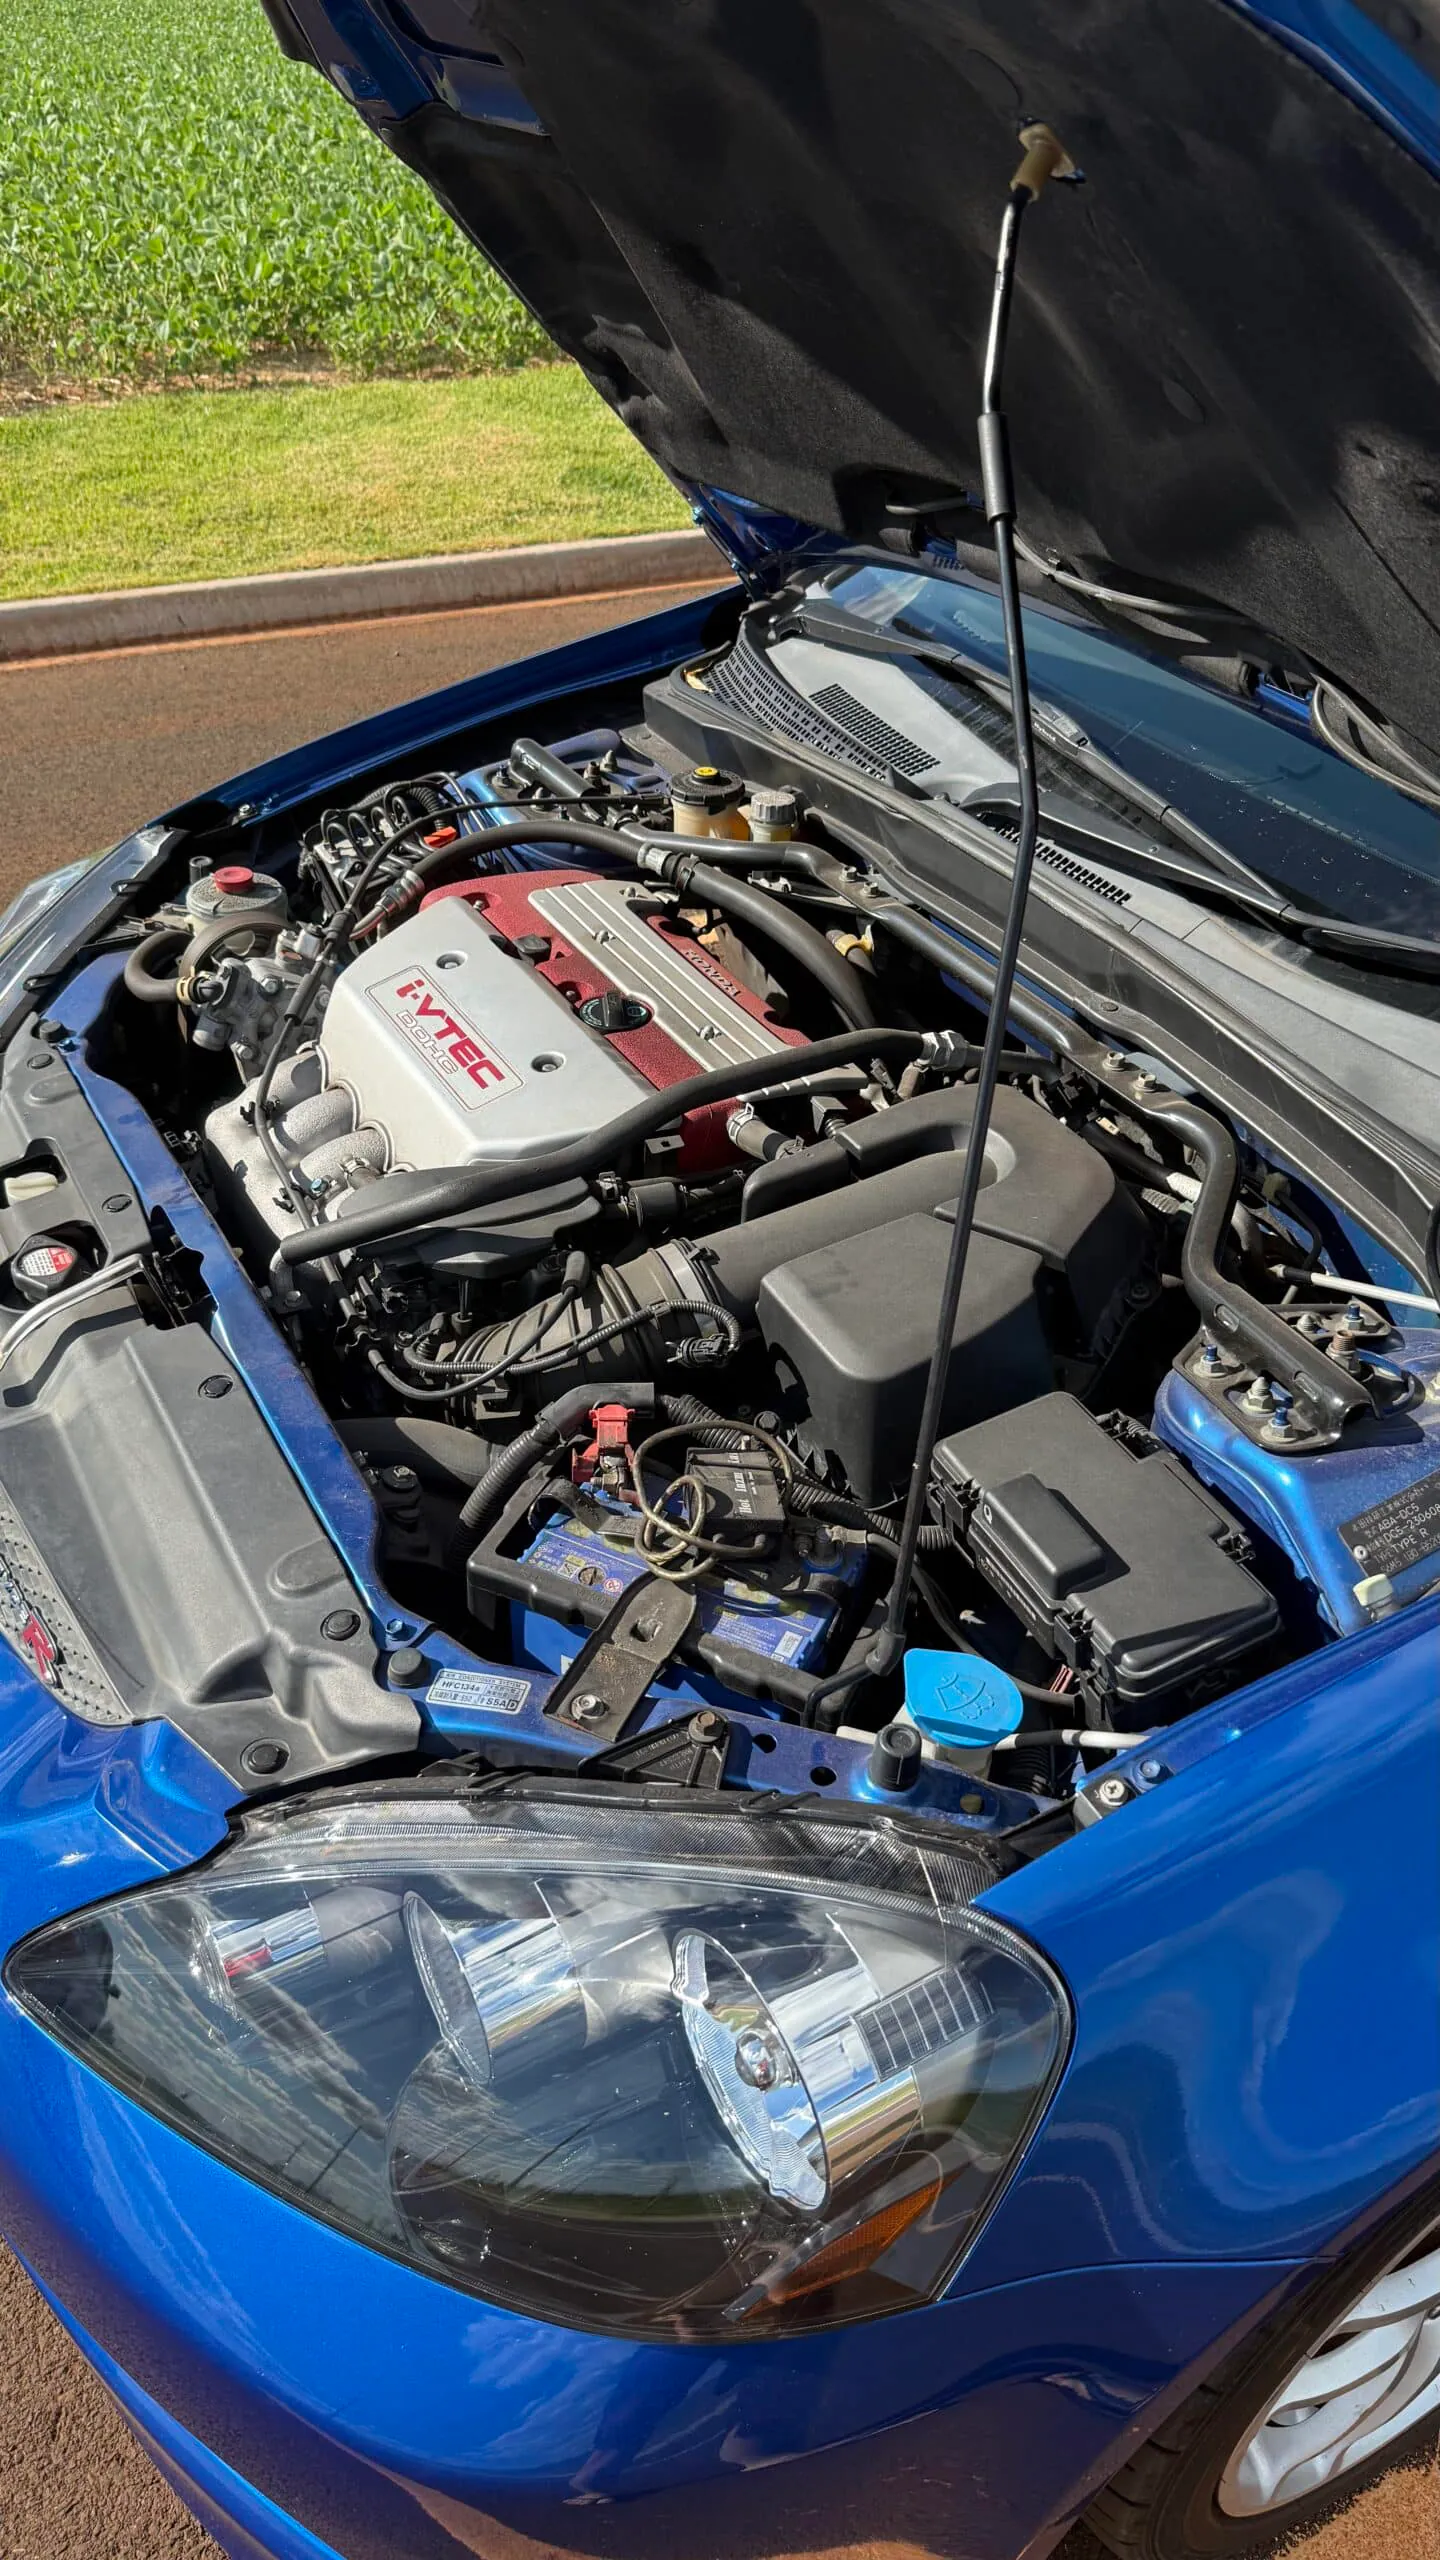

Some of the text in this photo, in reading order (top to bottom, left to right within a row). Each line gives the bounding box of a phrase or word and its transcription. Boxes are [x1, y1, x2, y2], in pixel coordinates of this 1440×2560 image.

[685, 947, 741, 997] HONDA
[396, 1009, 459, 1075] DOHC
[1378, 1502, 1420, 1532] ABA-DC5
[1390, 1534, 1418, 1553] TYPE
[1419, 1527, 1430, 1539] R
